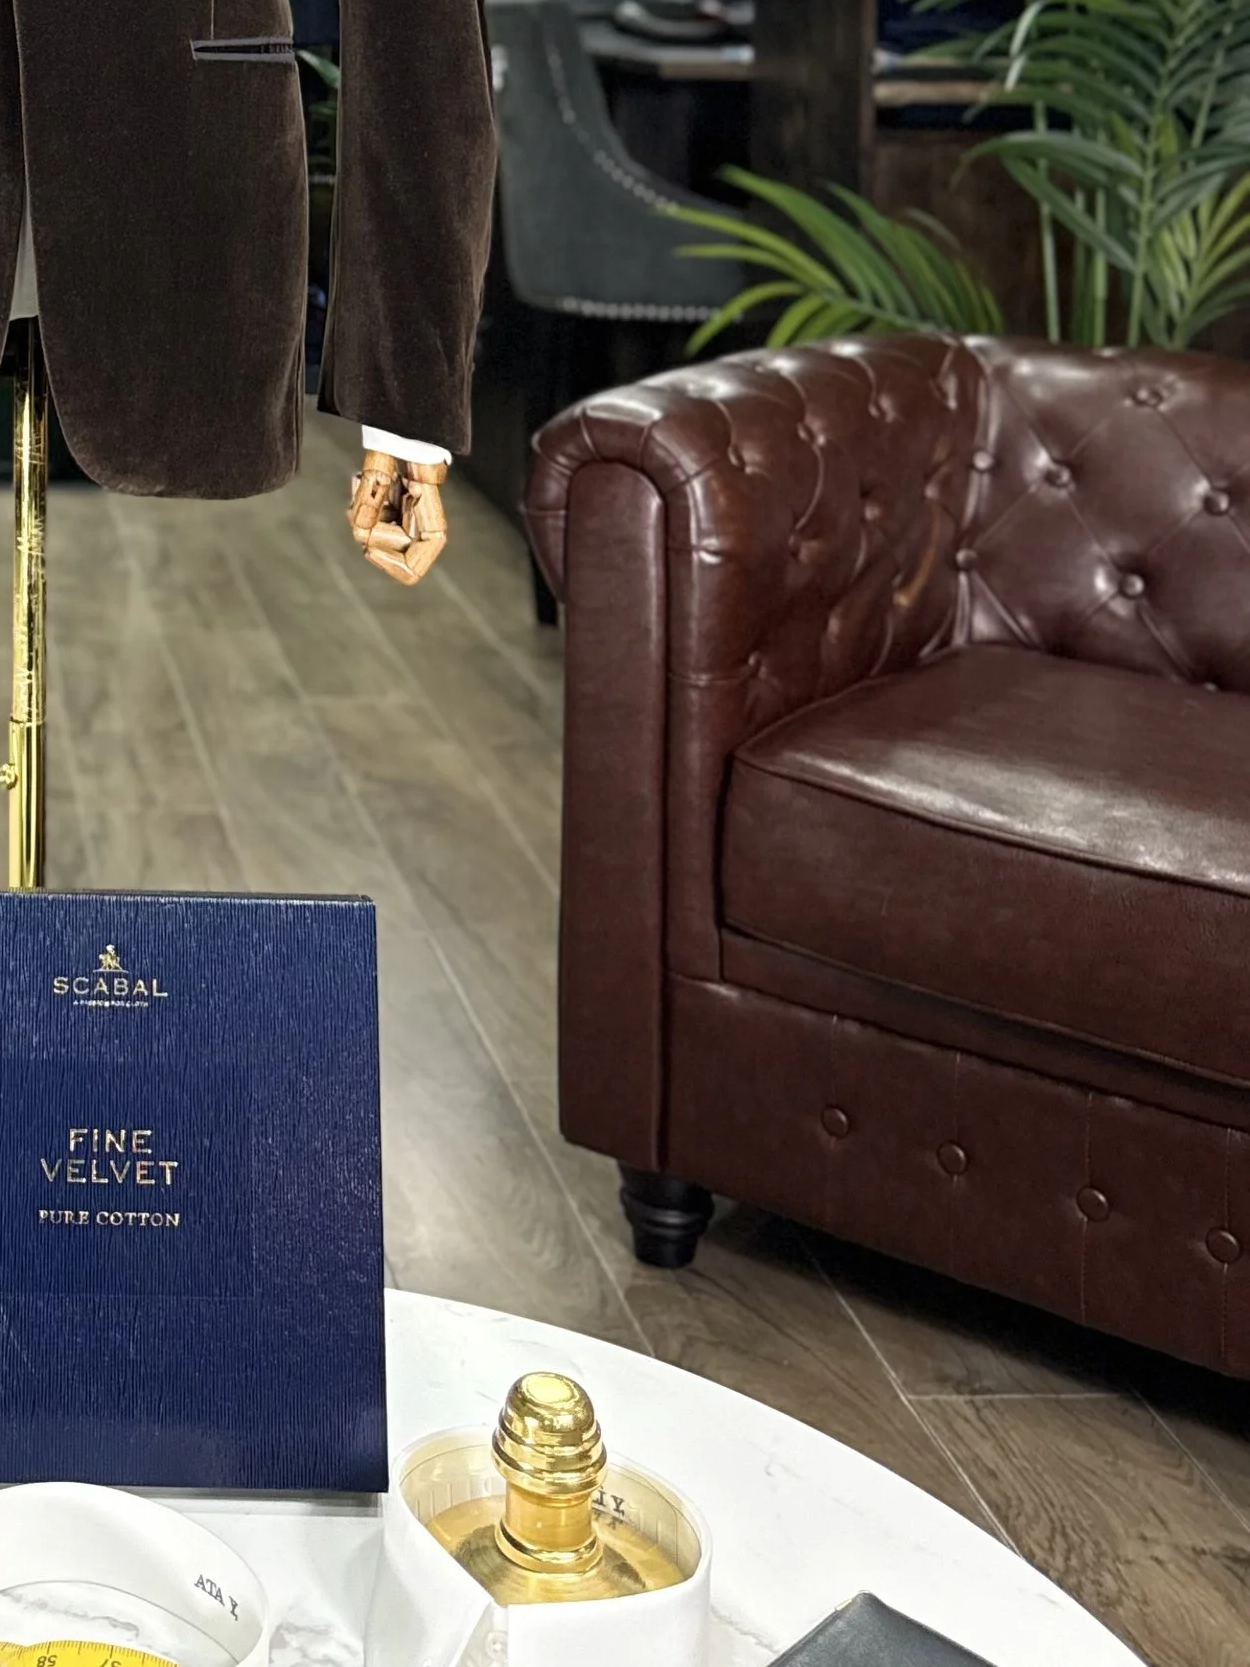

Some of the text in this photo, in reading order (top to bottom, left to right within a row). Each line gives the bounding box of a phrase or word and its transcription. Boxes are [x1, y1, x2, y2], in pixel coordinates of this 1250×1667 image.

[53, 976, 168, 997] SCABAL
[69, 1128, 152, 1154] FINE
[41, 1158, 178, 1185] VELVET
[38, 1210, 180, 1227] PURE COTTON
[193, 1574, 225, 1607] ATA
